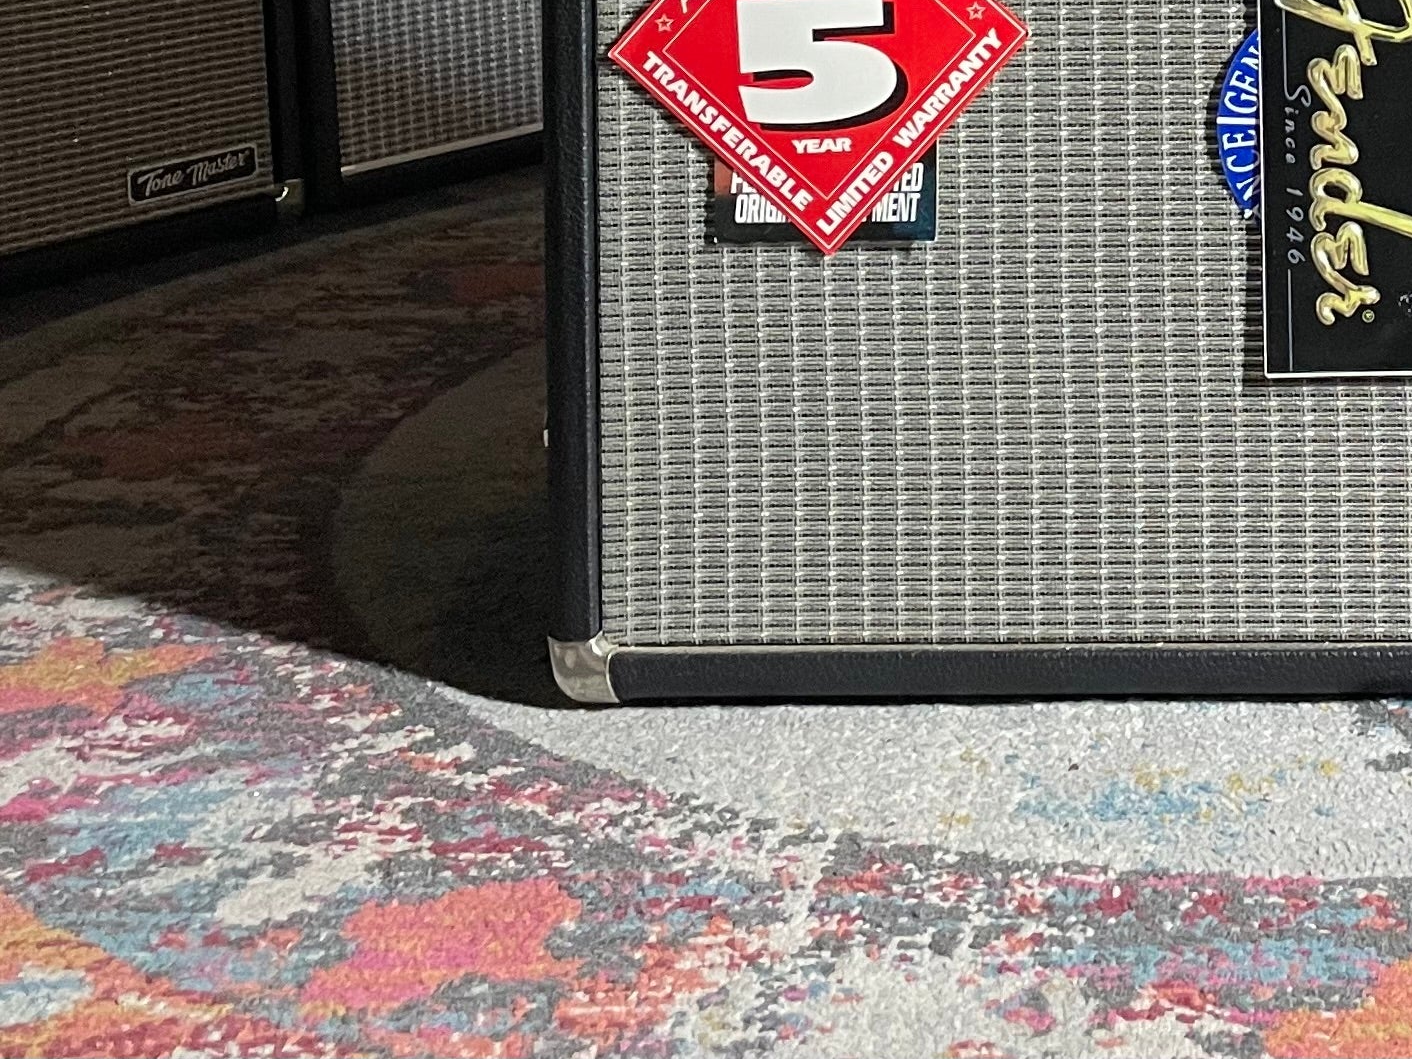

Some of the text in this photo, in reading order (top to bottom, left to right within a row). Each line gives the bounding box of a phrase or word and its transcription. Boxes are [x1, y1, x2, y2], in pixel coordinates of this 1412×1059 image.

[137, 150, 249, 197] Tone Master
[642, 51, 817, 212] TRANSFERABLE
[792, 137, 852, 154] YEAR
[816, 151, 895, 236] LIMITED
[893, 27, 1003, 150] WARRANTY
[1283, 83, 1311, 265] Since 1946
